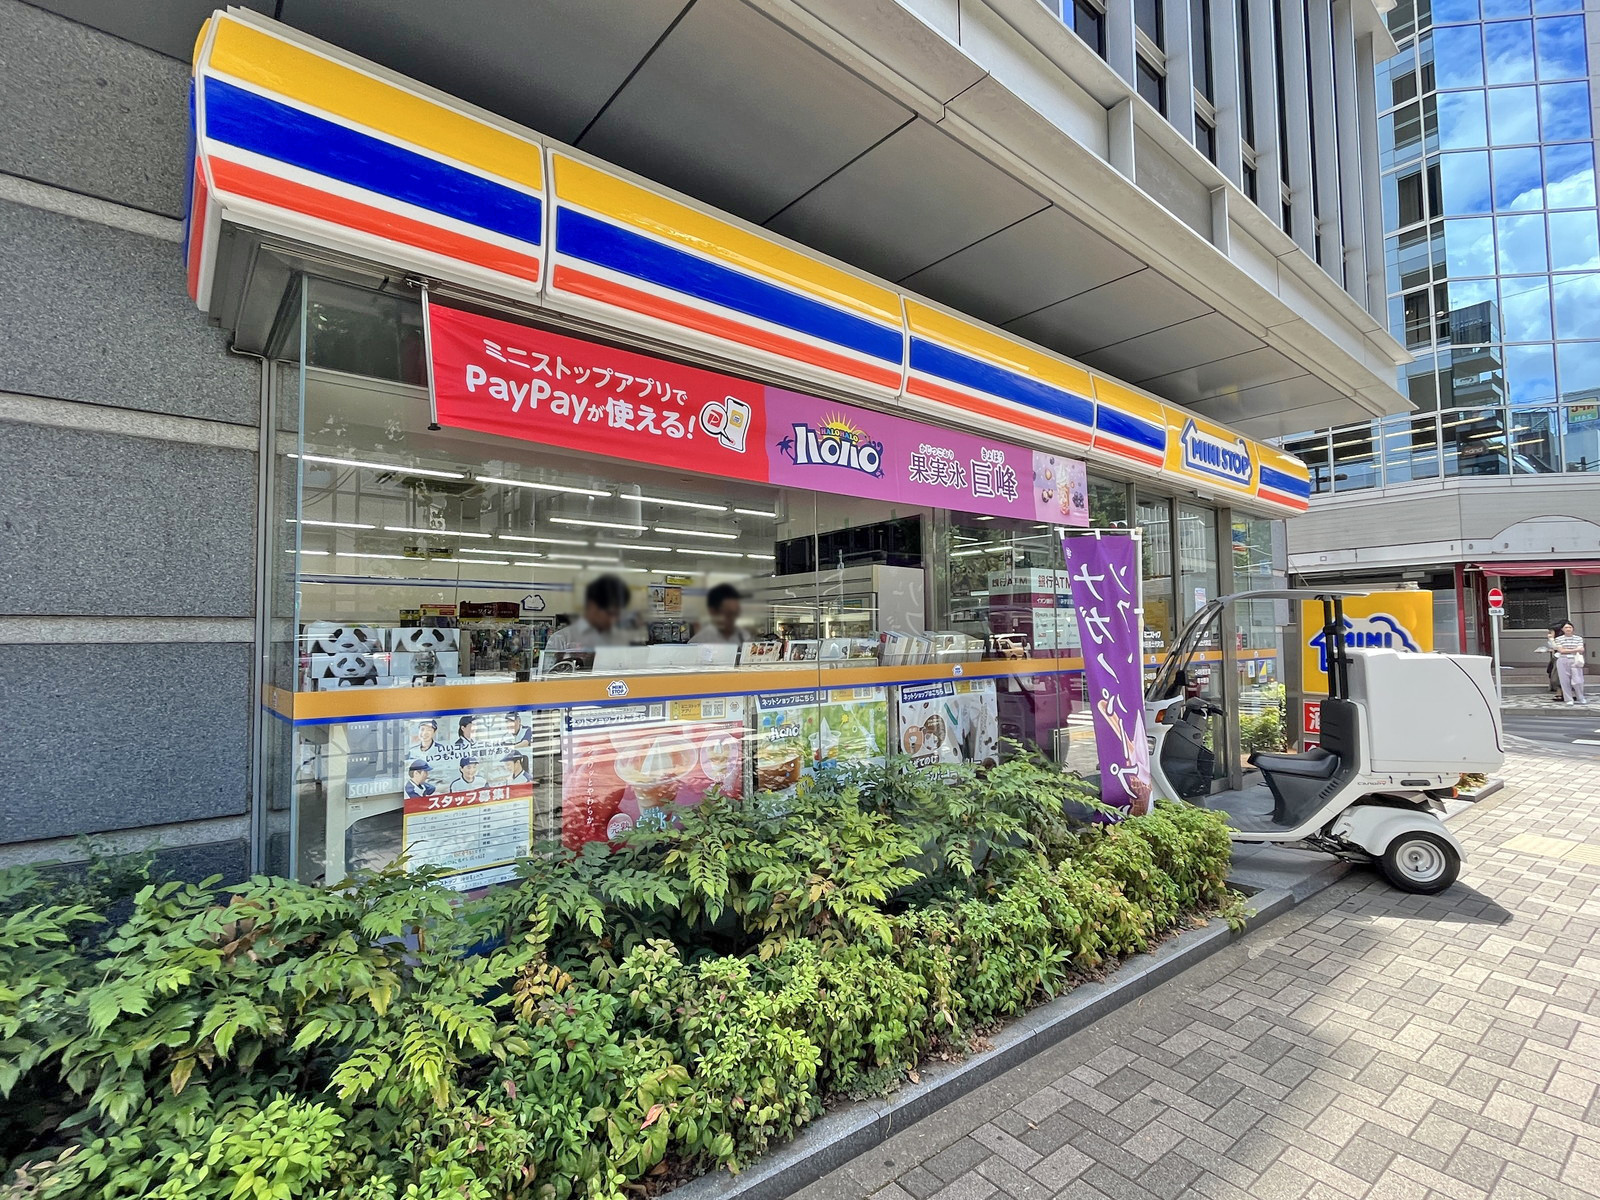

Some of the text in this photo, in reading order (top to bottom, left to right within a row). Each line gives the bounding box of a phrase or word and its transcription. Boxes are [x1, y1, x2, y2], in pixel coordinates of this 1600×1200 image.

[483, 338, 688, 405] ミニストップアプリで
[820, 427, 858, 442] HALOHALO
[981, 447, 1004, 464] きょほう
[1192, 437, 1250, 476] MINI STOP
[909, 453, 1018, 502] 果実氷 巨峰
[762, 694, 815, 706] ネットショップはこちら
[903, 688, 944, 700] ネットショップはこちら
[428, 787, 510, 809] スタッフ募集!
